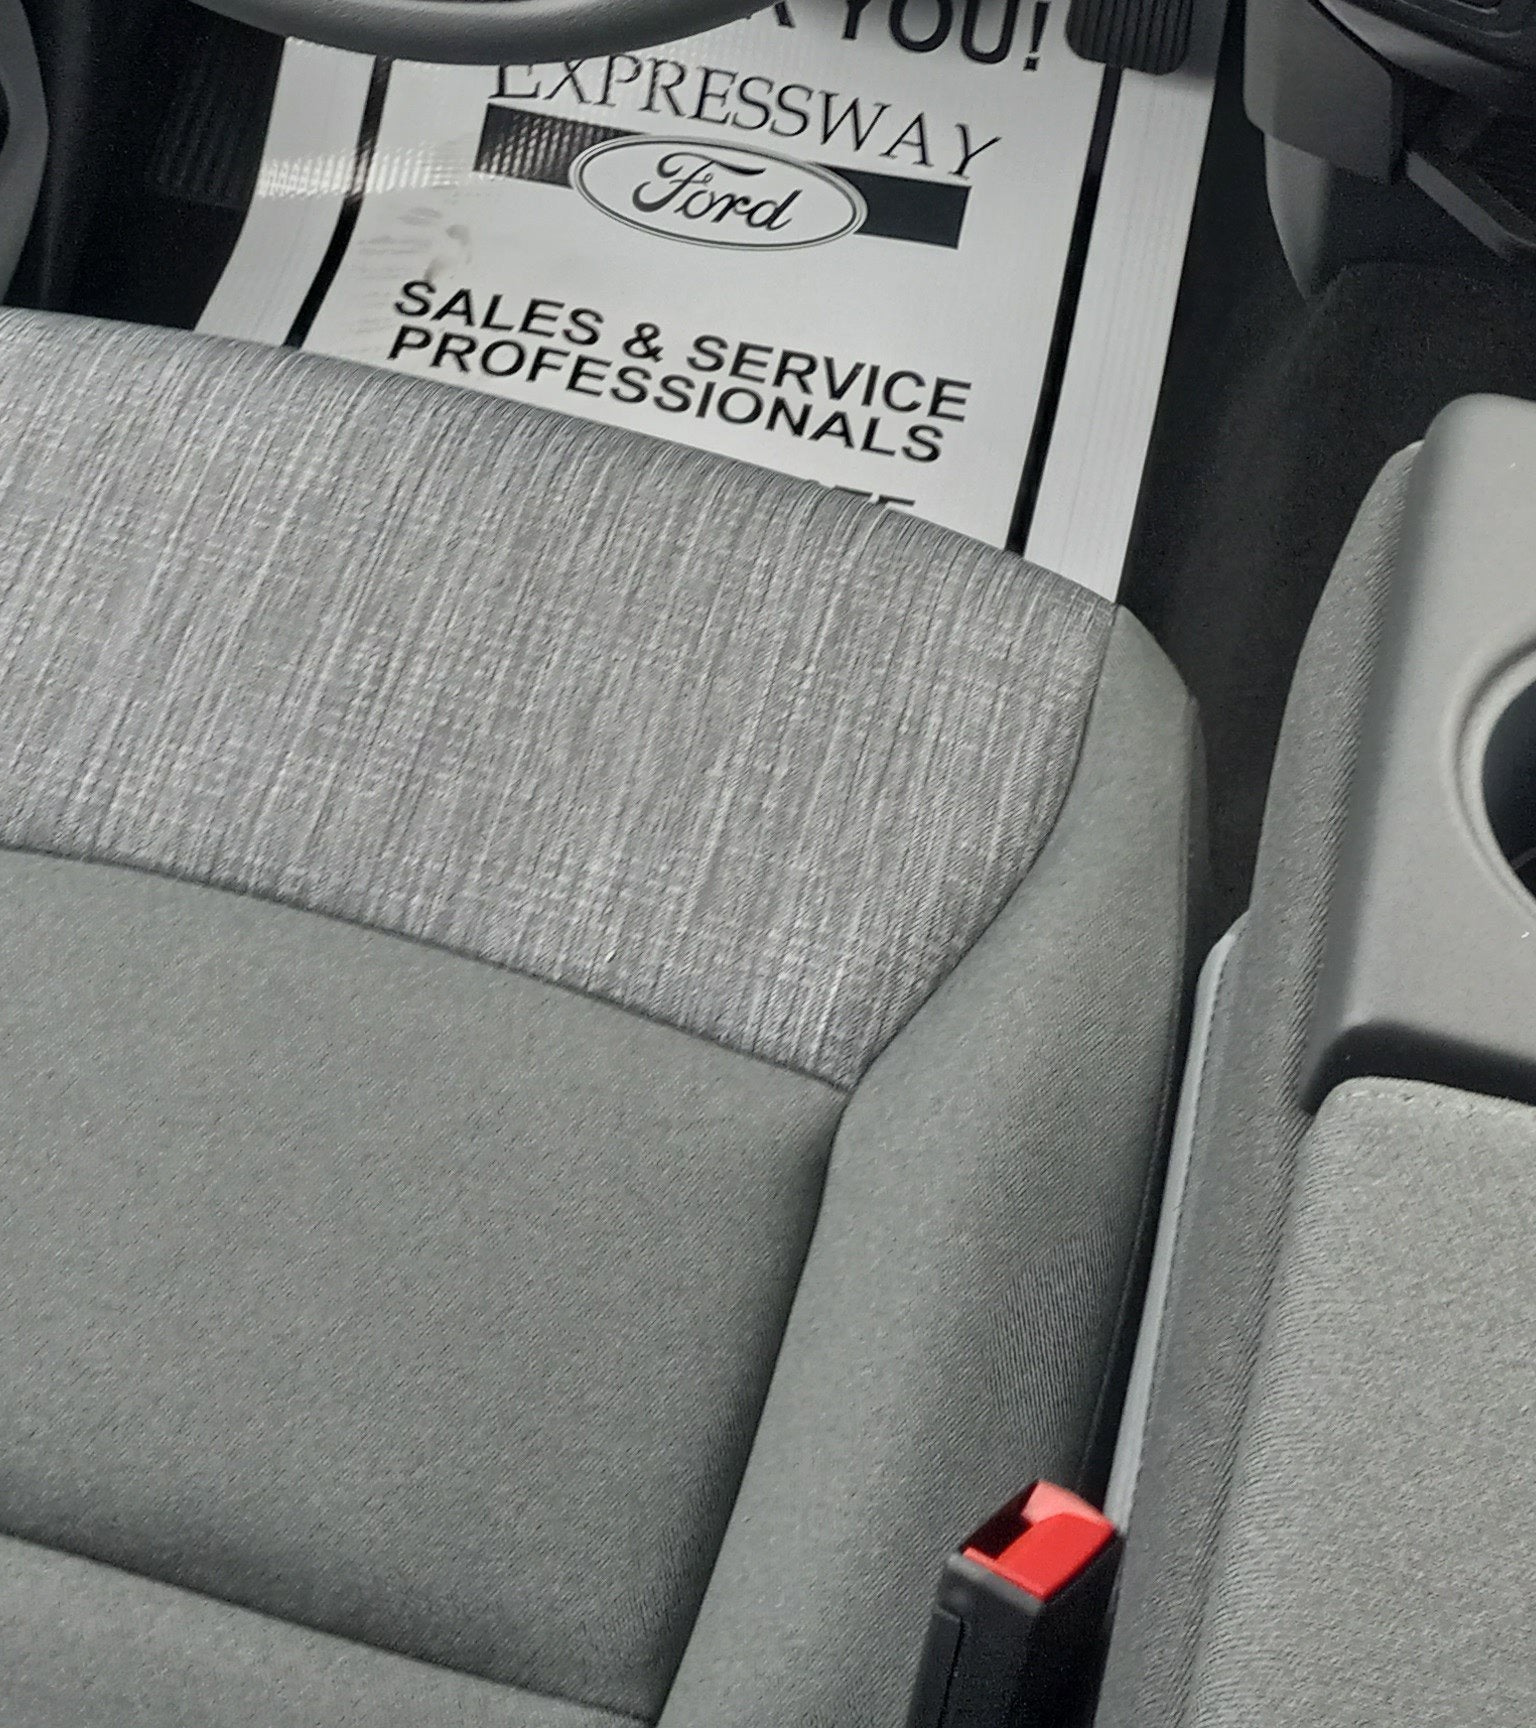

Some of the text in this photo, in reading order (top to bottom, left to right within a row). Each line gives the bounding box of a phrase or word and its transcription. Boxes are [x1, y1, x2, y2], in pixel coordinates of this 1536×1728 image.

[489, 53, 1002, 181] EXPRESSWAY
[631, 150, 803, 232] Ford
[387, 324, 945, 464] PROFESSIONALS
[393, 279, 973, 423] SALES & SERVICE
